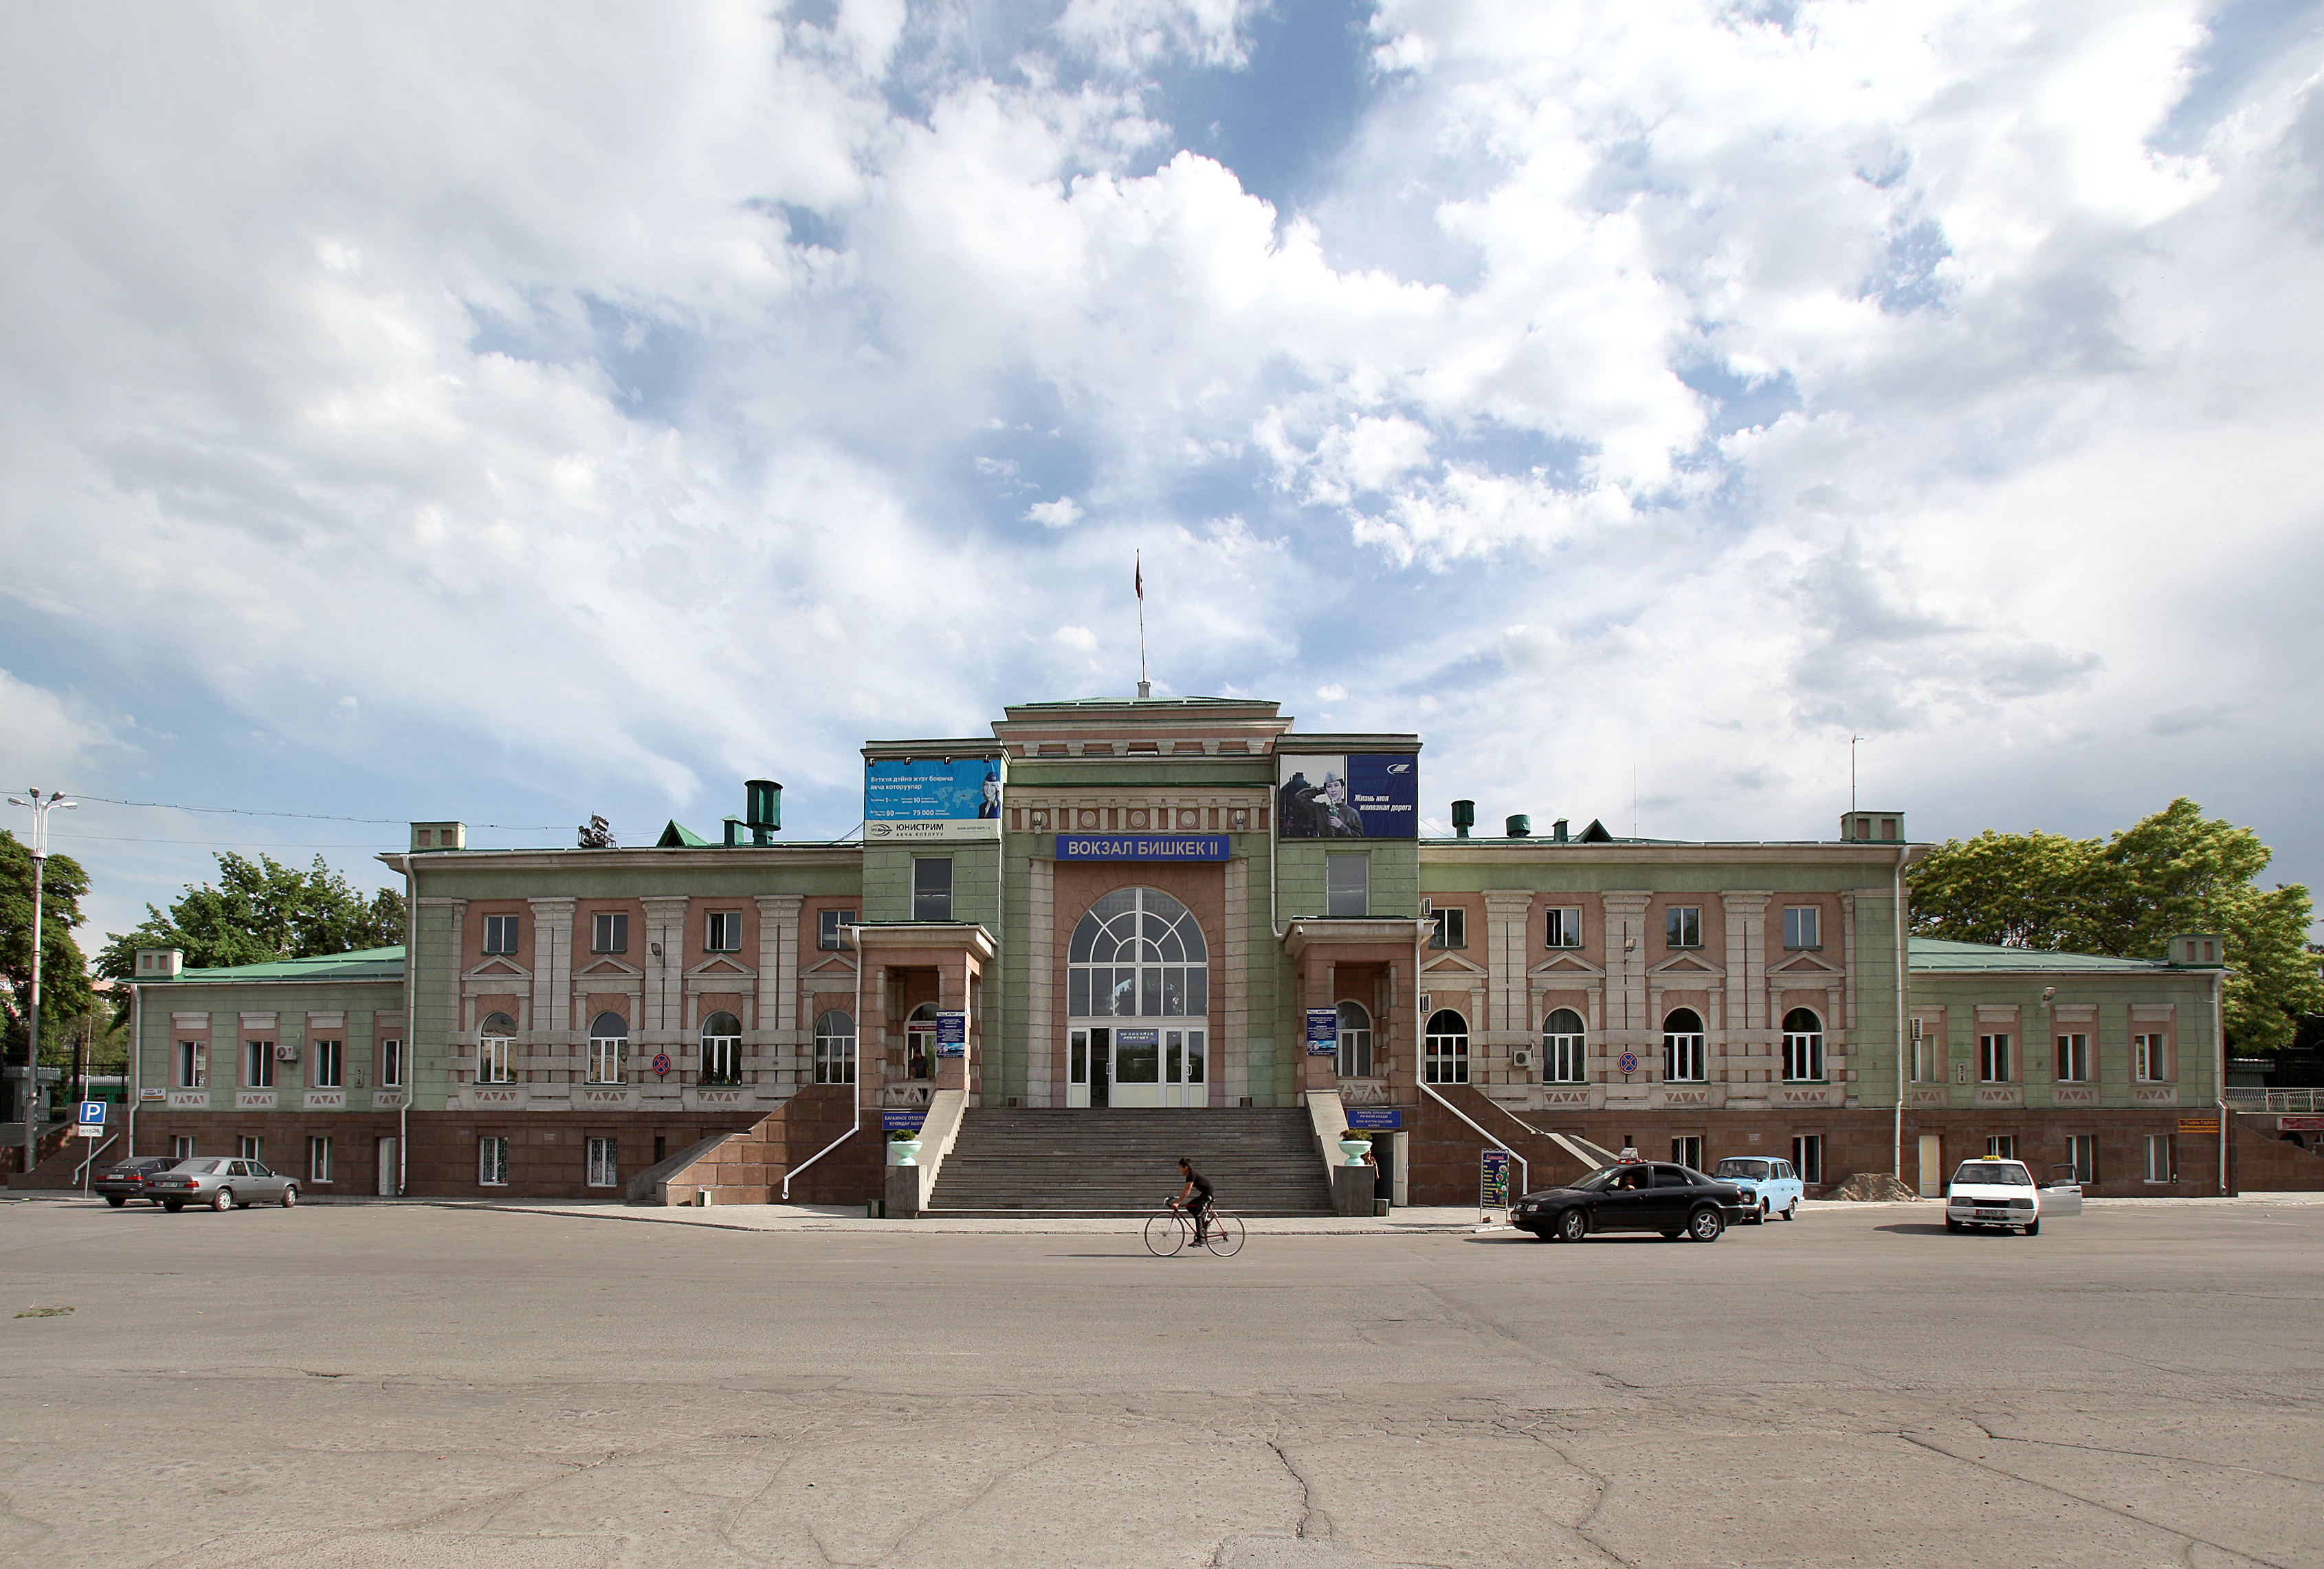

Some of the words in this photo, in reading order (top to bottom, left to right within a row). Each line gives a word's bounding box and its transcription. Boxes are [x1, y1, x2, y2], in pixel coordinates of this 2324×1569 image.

[1354, 794, 1375, 802] Жизнь
[1391, 804, 1412, 812] дорога
[1068, 841, 1133, 855] ВОКЗАЛ
[1138, 841, 1205, 855] БИШКЕК
[1210, 841, 1218, 855] II
[86, 1104, 101, 1121] P
